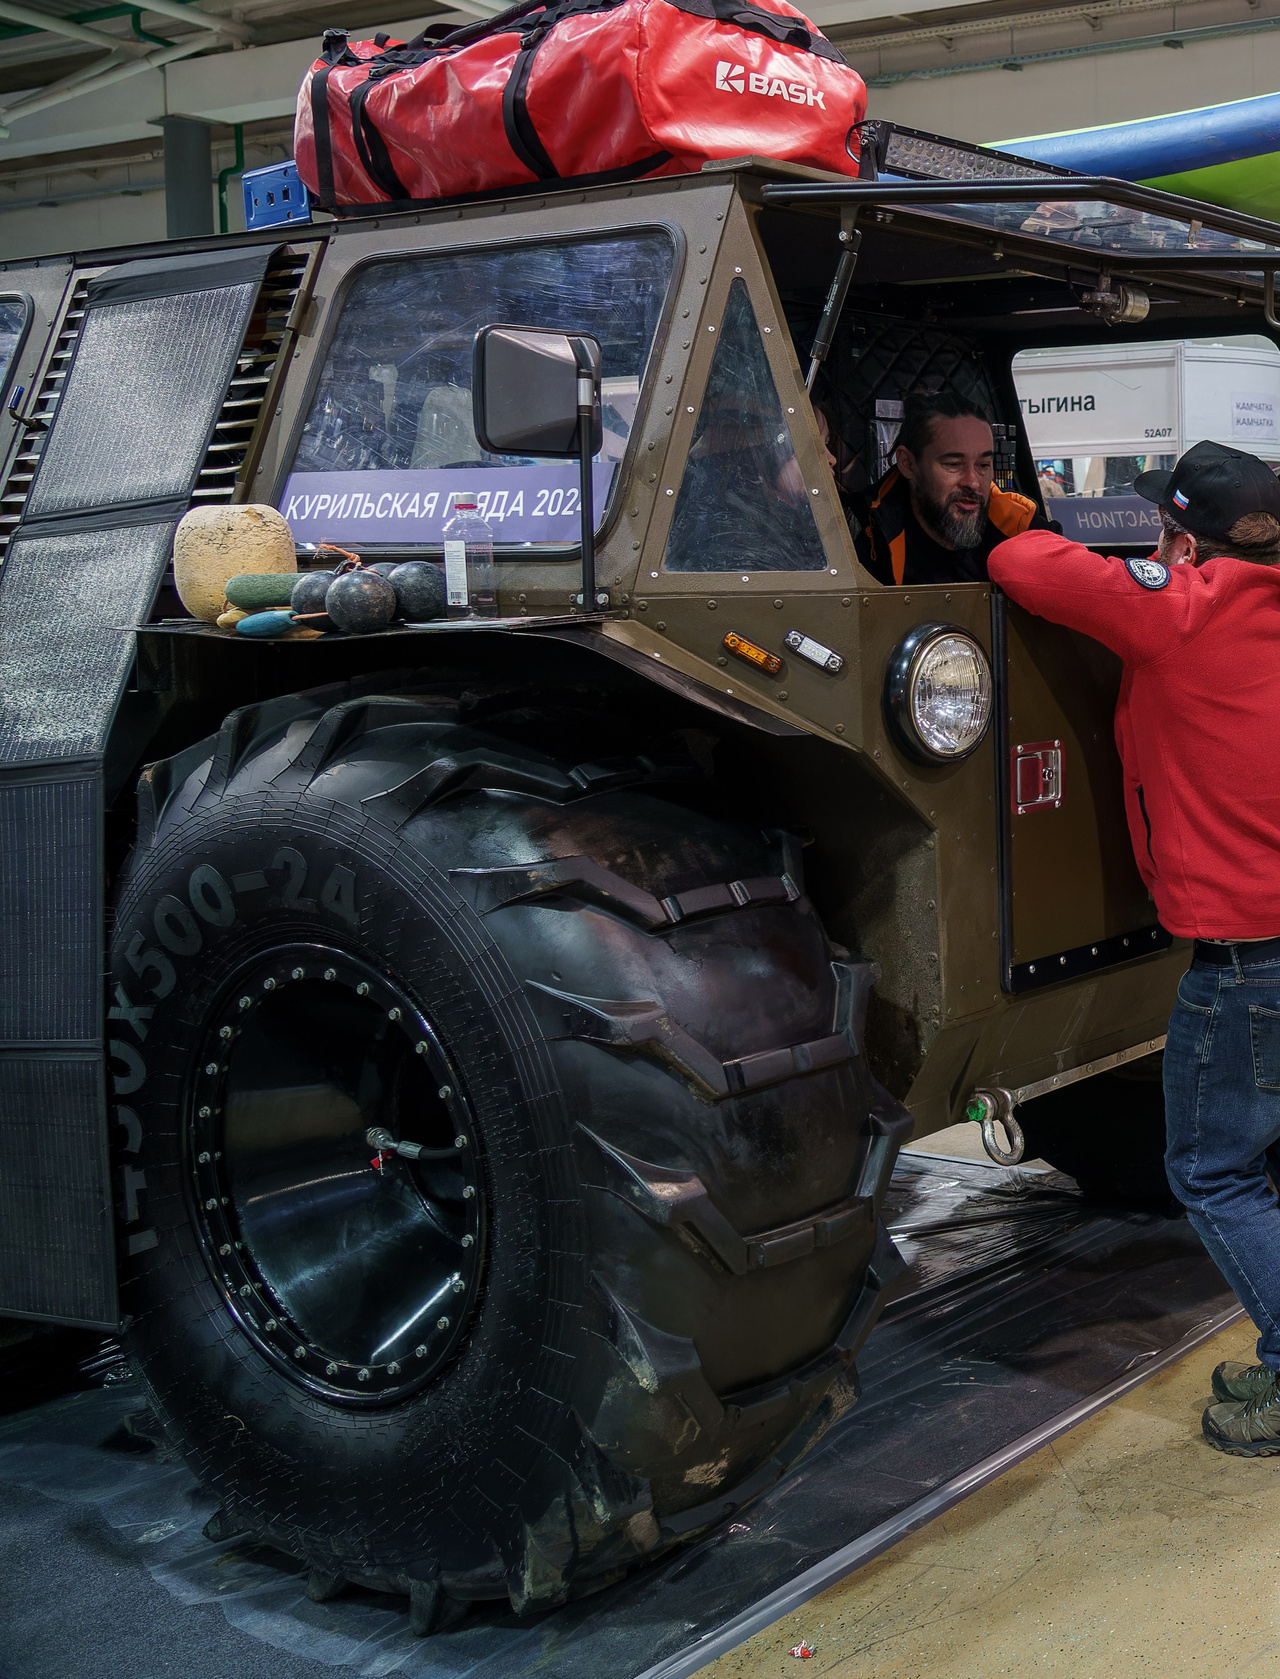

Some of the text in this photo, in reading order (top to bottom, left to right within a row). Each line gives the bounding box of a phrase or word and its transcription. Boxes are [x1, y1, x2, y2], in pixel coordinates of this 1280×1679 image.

[749, 72, 827, 110] BASK
[285, 488, 582, 522] КУРИЛЬСКАЯ ГЯДА 202
